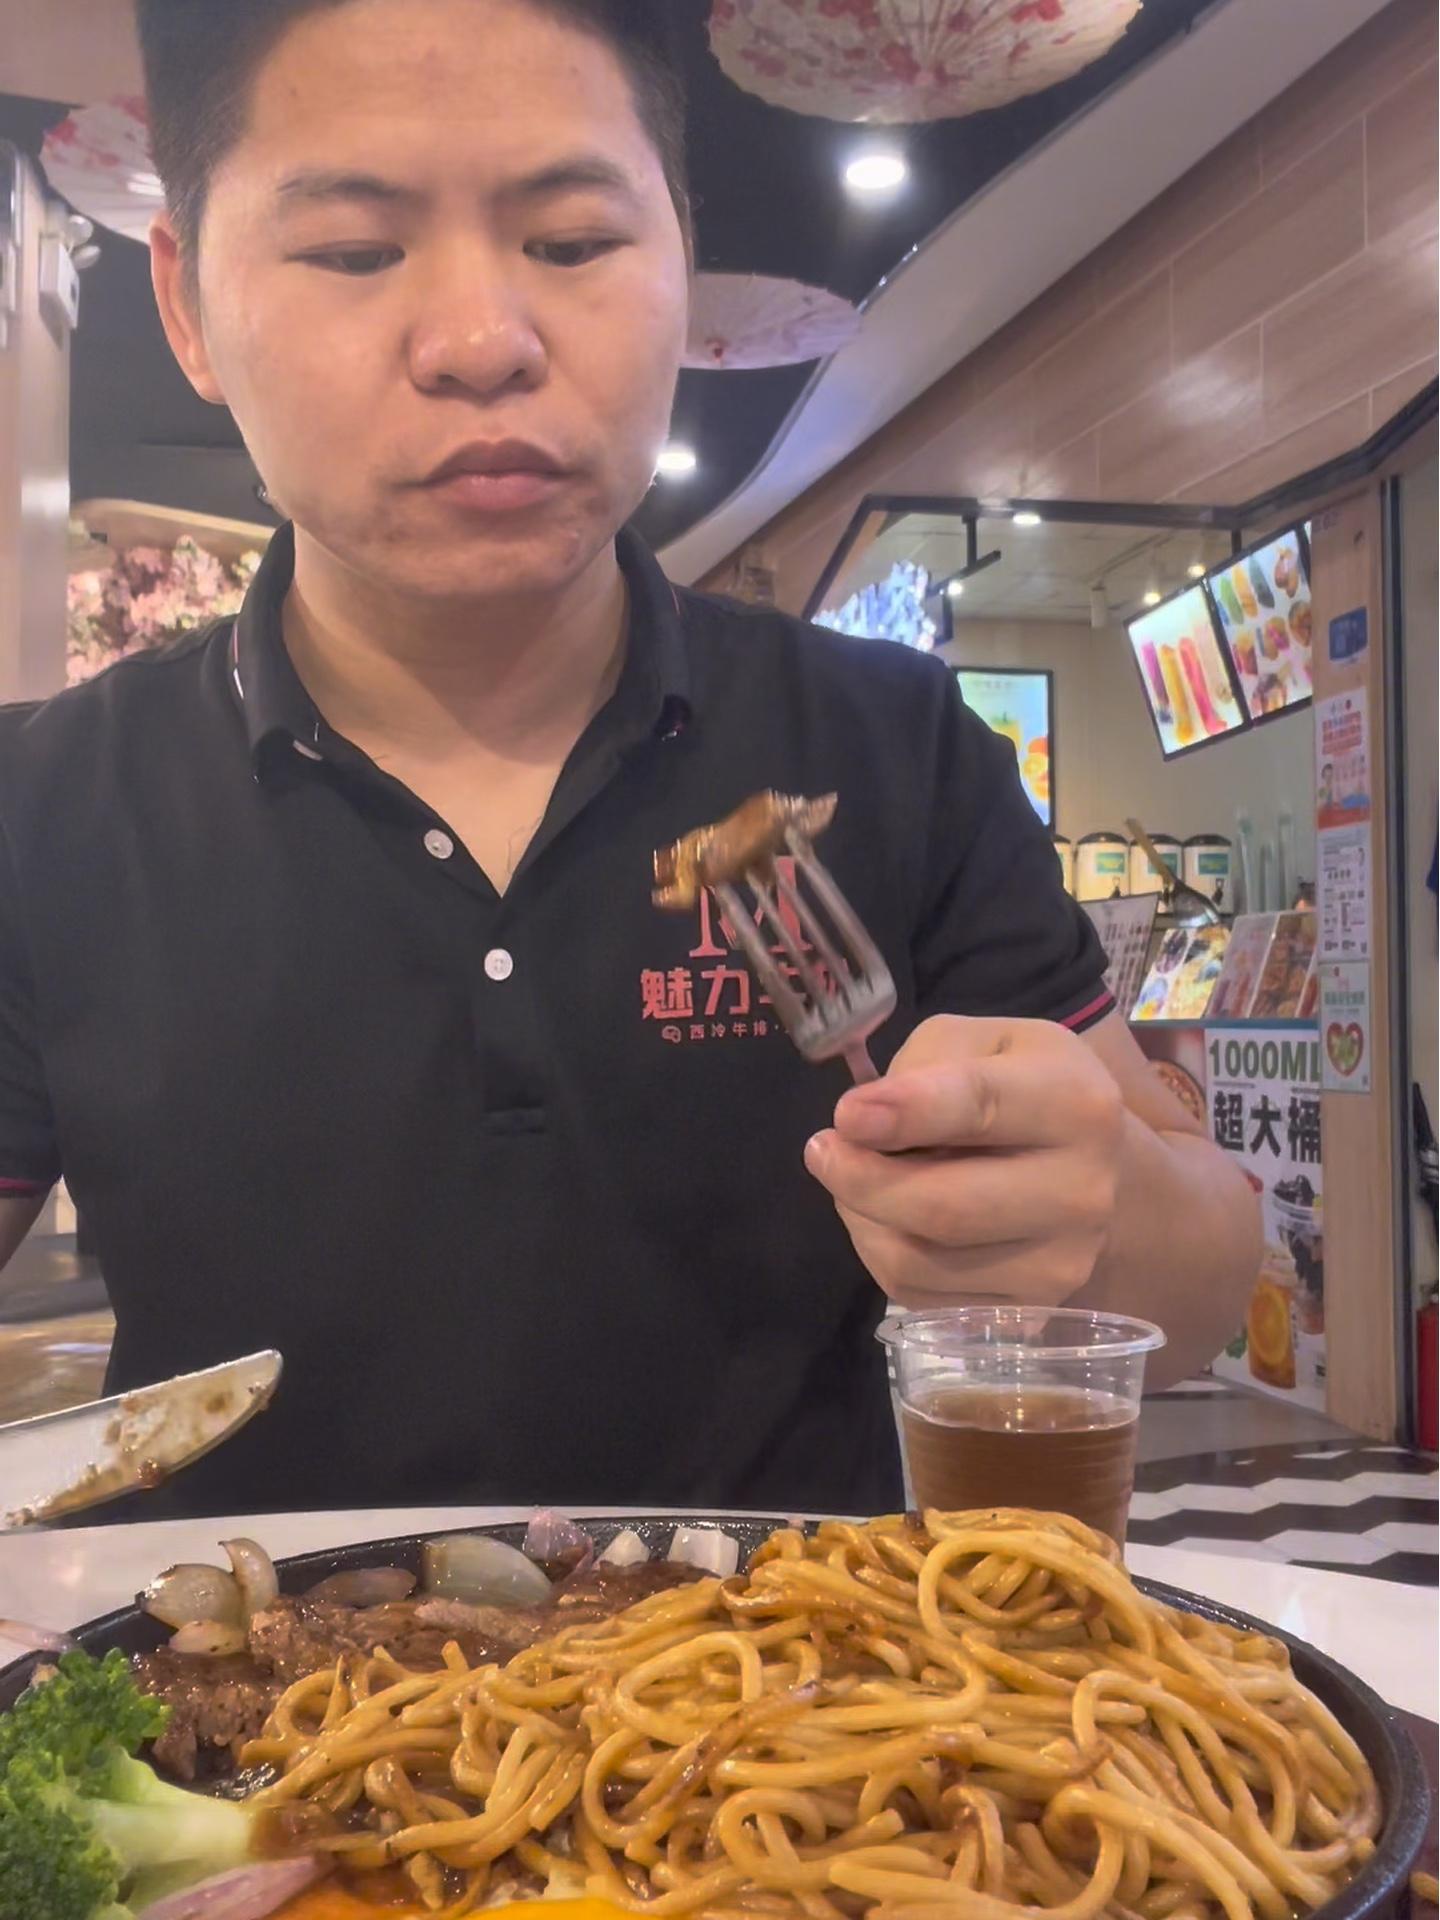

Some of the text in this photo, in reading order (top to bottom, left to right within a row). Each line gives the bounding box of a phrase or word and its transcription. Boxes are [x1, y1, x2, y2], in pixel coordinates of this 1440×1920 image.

[1209, 1039, 1320, 1082] 1000ML
[1213, 1090, 1321, 1164] 超大桶
